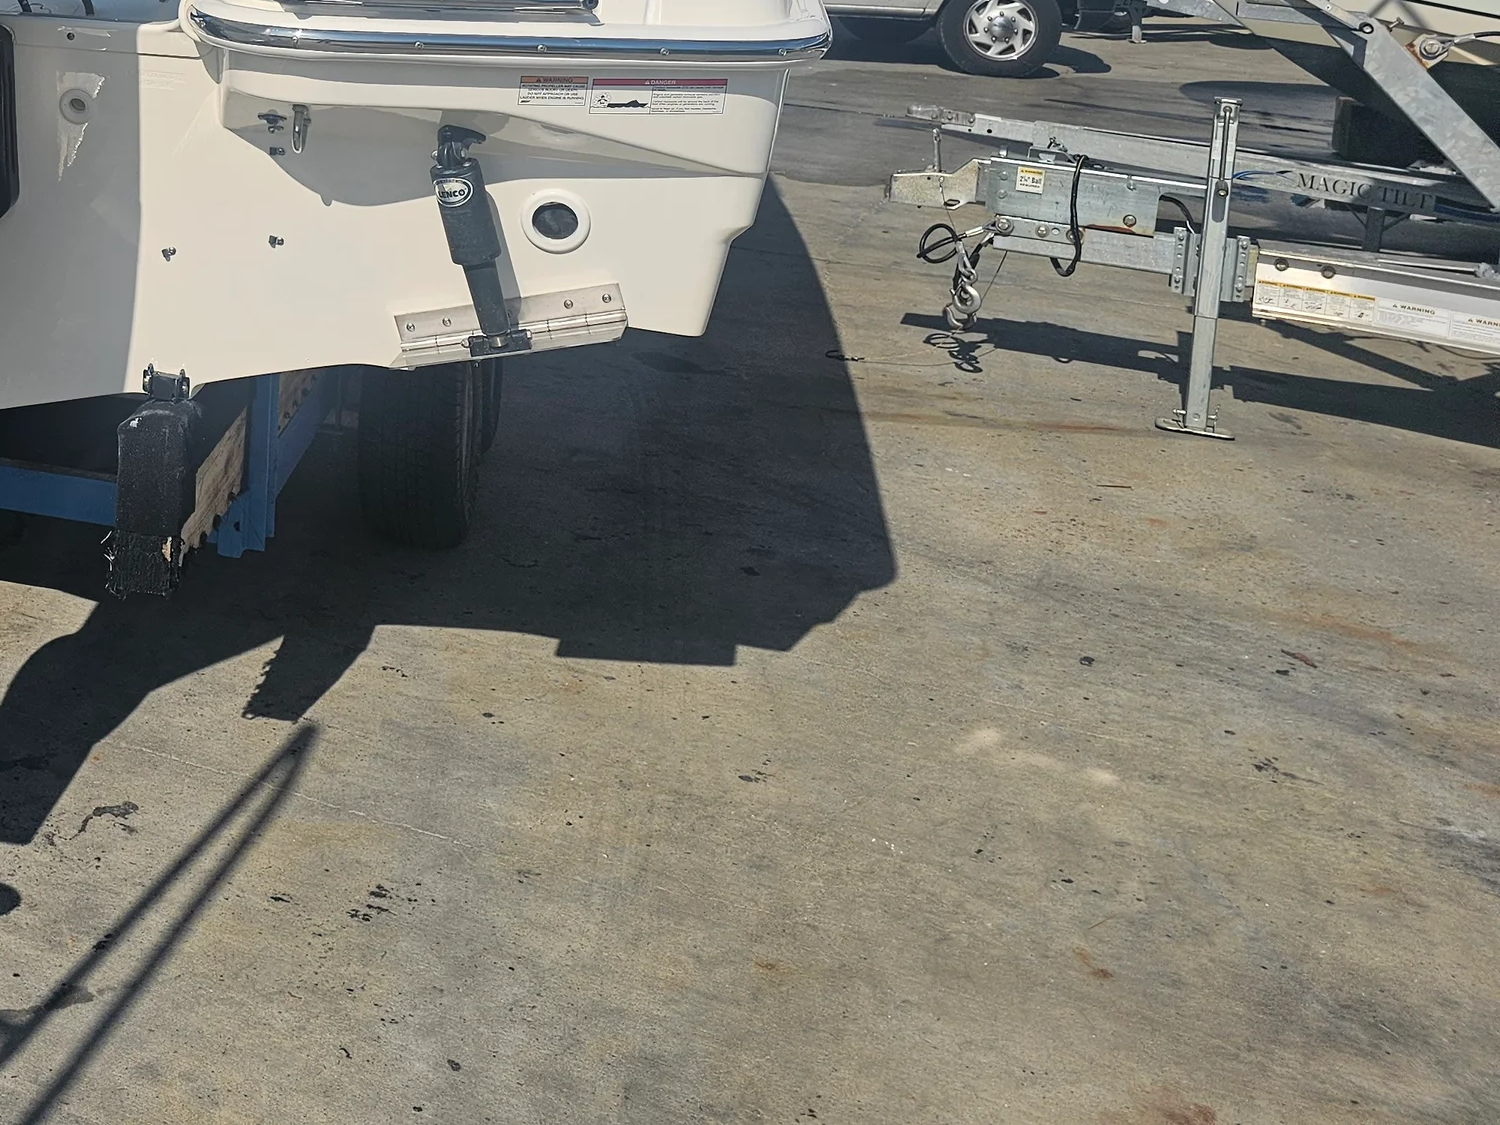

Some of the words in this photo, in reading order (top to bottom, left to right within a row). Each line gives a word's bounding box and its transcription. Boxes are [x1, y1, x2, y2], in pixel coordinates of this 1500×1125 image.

[438, 189, 466, 199] LENCO
[1297, 172, 1372, 199] MAGIC
[1378, 185, 1434, 210] TILT
[1400, 304, 1436, 316] WARNING
